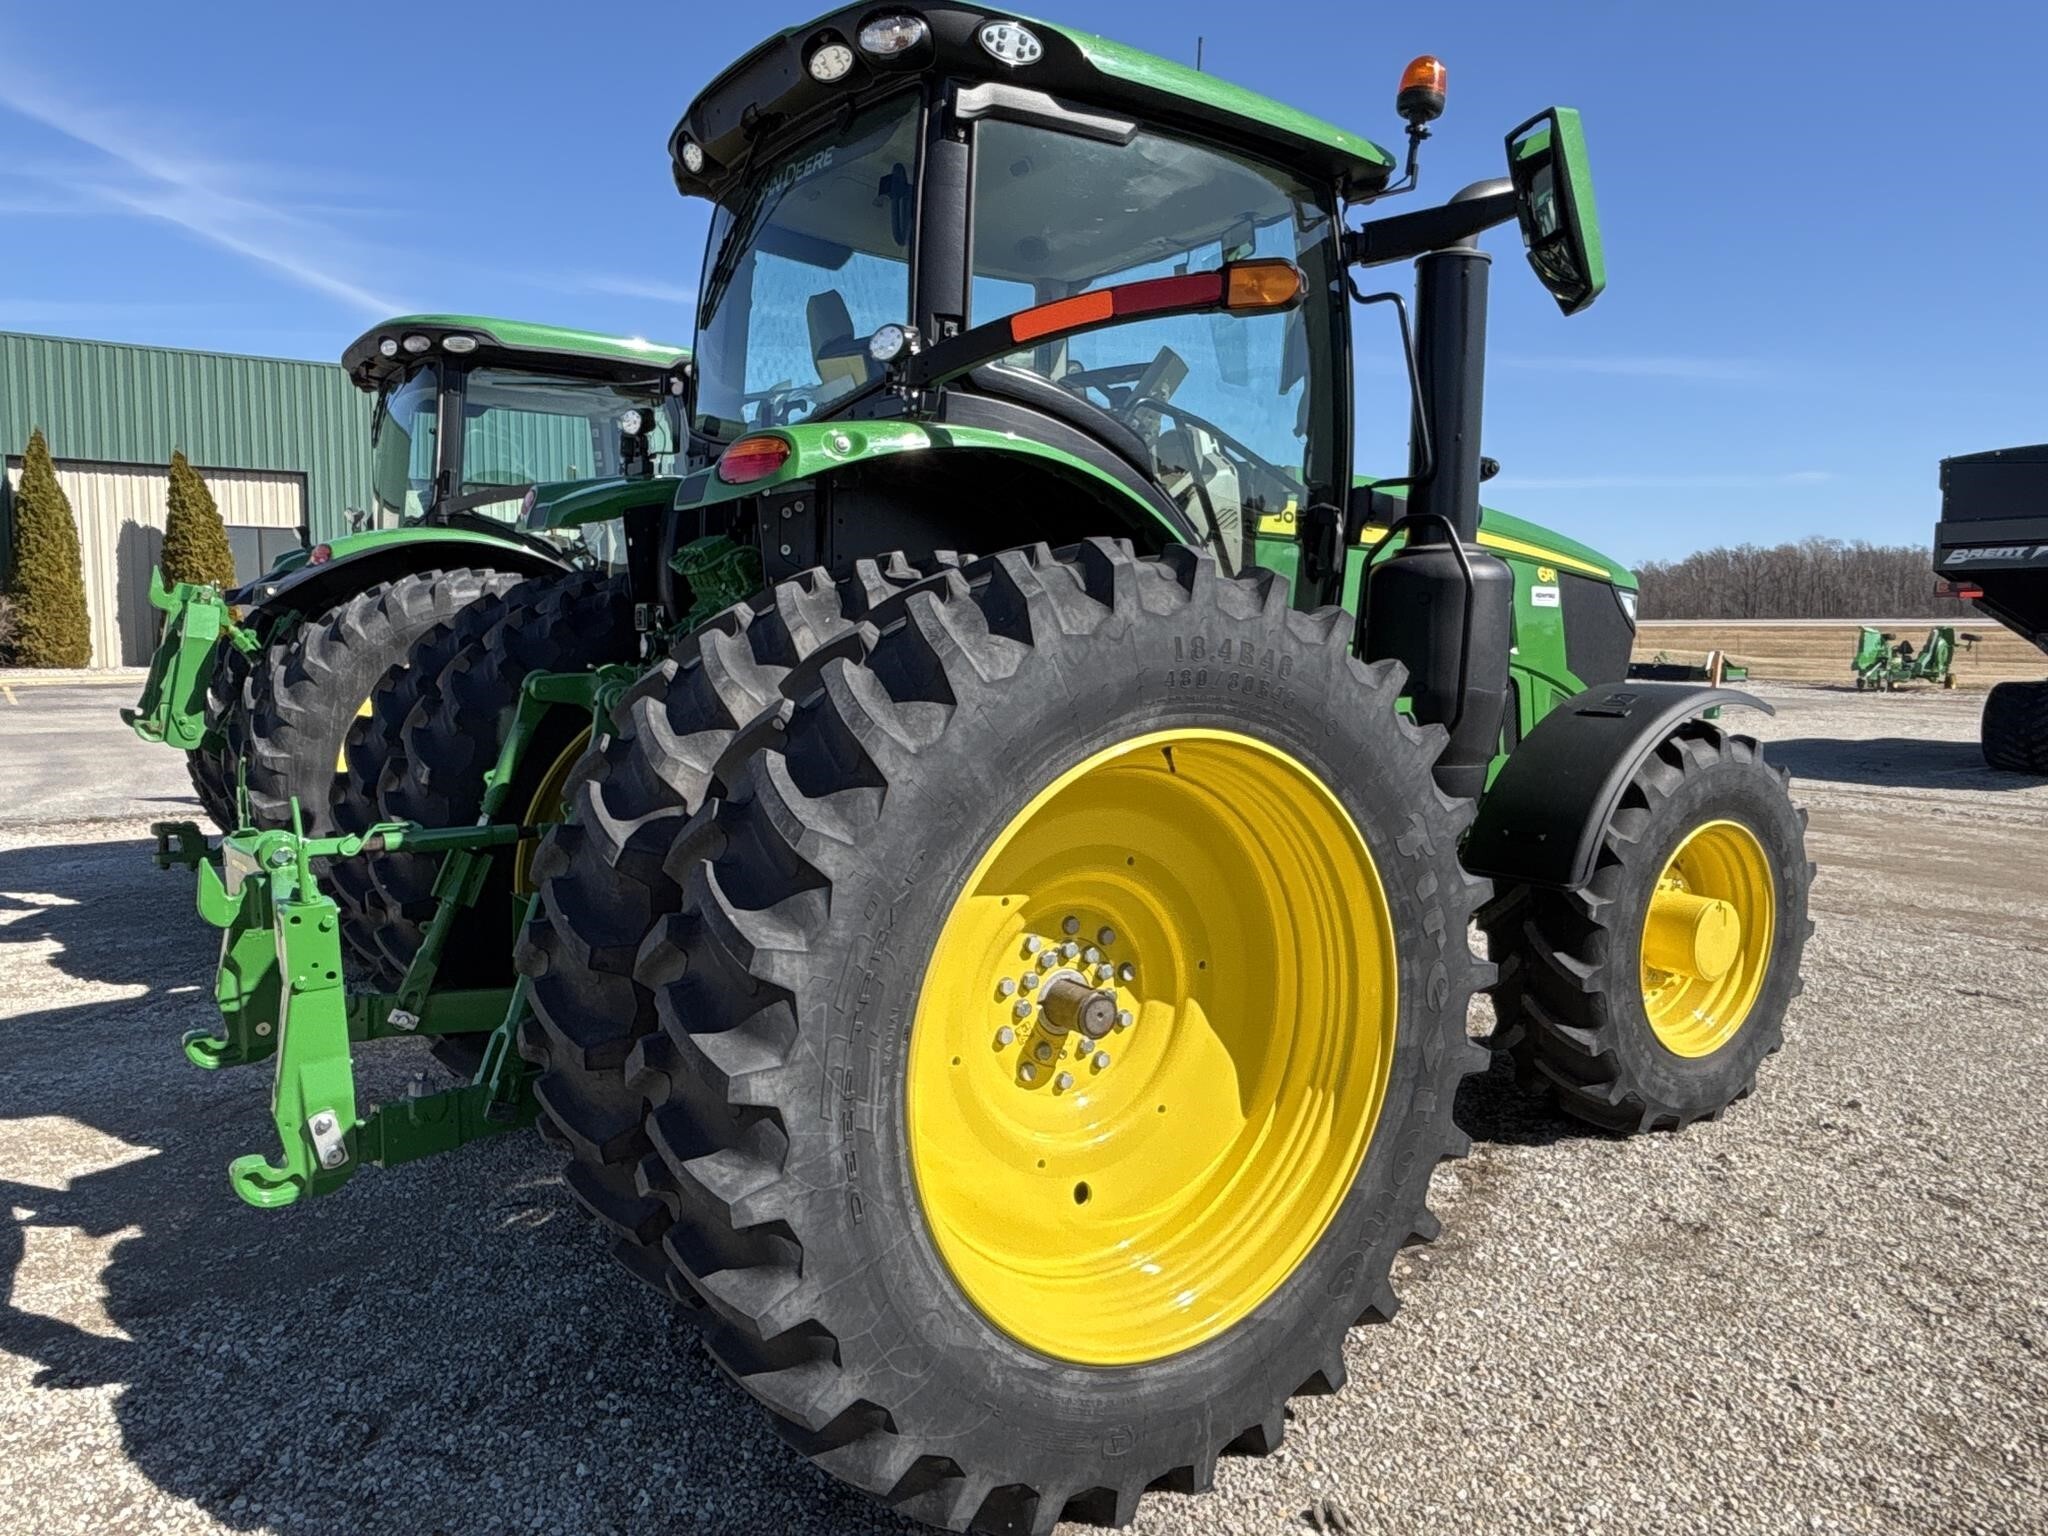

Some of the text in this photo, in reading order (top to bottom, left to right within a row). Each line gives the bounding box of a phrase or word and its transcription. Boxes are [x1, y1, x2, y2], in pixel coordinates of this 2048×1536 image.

[783, 145, 836, 185] DEERE
[1273, 510, 1295, 524] JO
[1943, 547, 2030, 564] BRENT
[1537, 566, 1556, 583] 6R
[1172, 635, 1294, 681] 18.4R46
